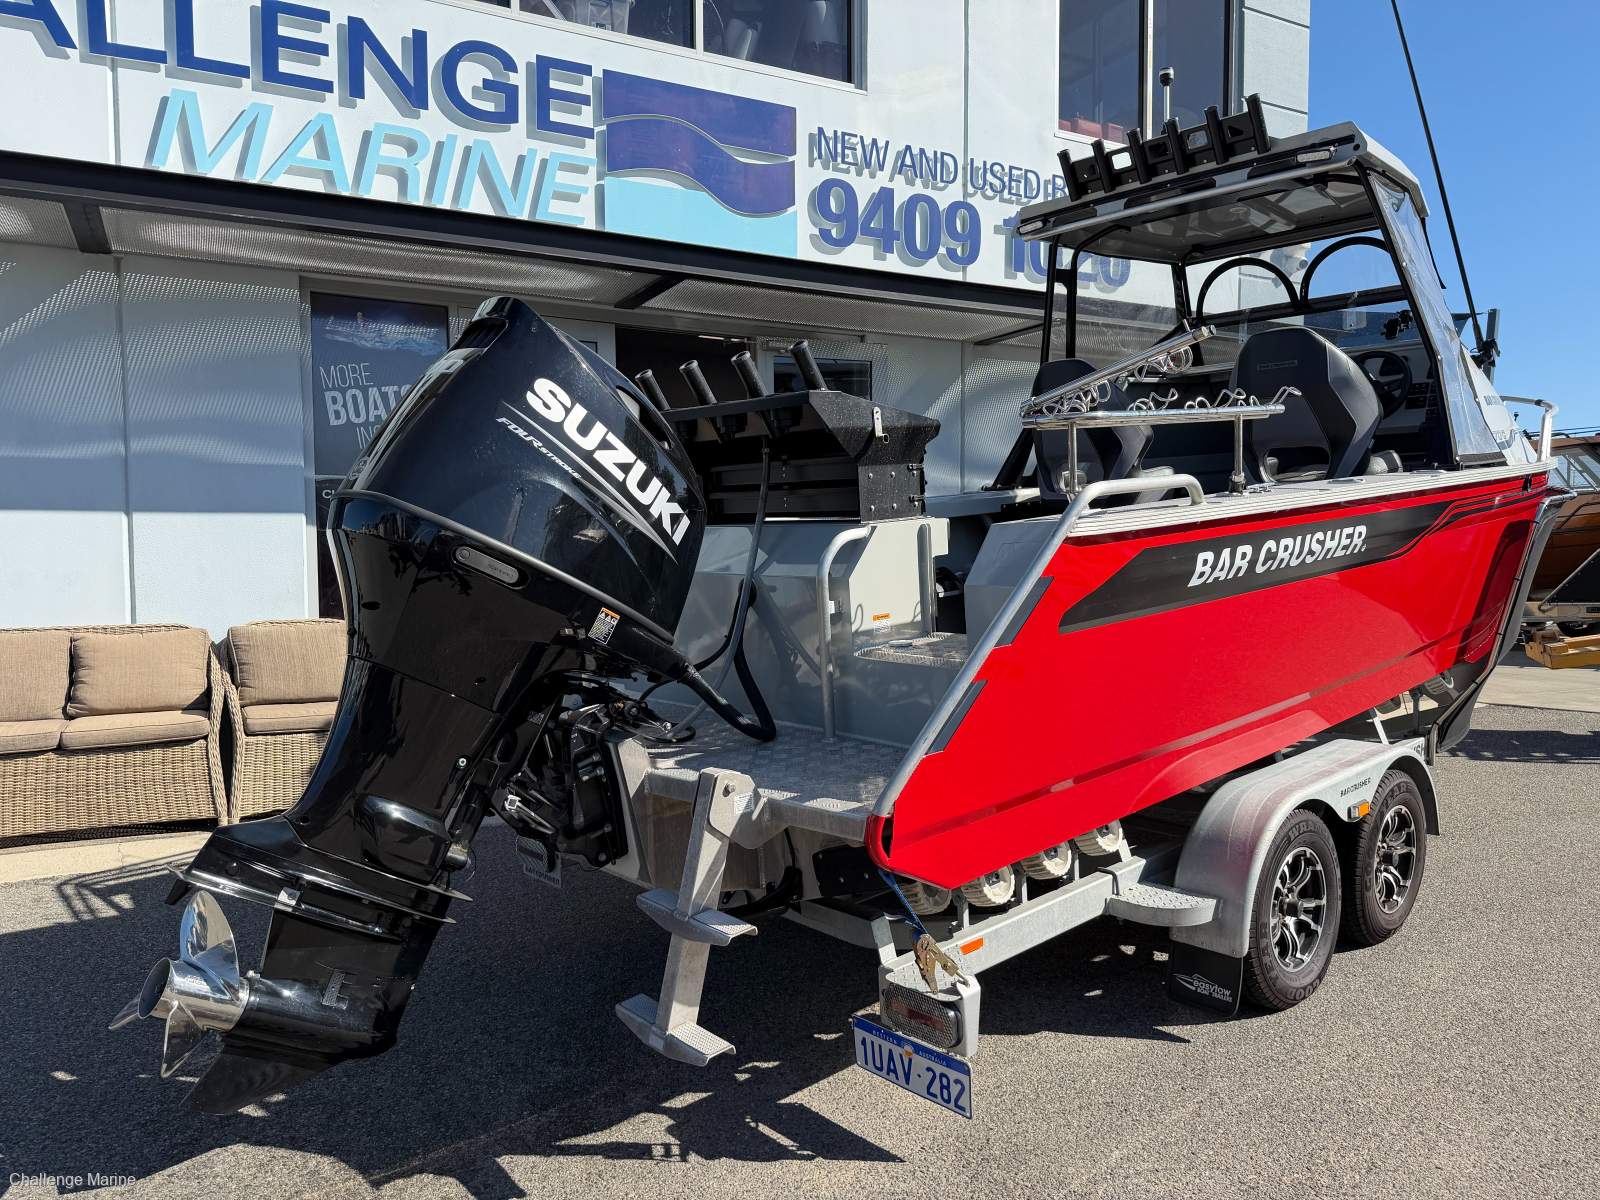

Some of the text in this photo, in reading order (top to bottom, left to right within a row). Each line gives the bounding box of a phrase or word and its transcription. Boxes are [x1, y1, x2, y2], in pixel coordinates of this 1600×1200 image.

[151, 88, 598, 226] MARINE
[816, 126, 890, 172] NEW
[897, 145, 959, 185] AND
[968, 157, 1041, 200] USED
[816, 178, 981, 266] 9409
[319, 362, 374, 389] MORE
[323, 384, 412, 426] BOAT
[526, 377, 691, 546] SUZUKI
[1187, 524, 1367, 588] BAR CRUSHER
